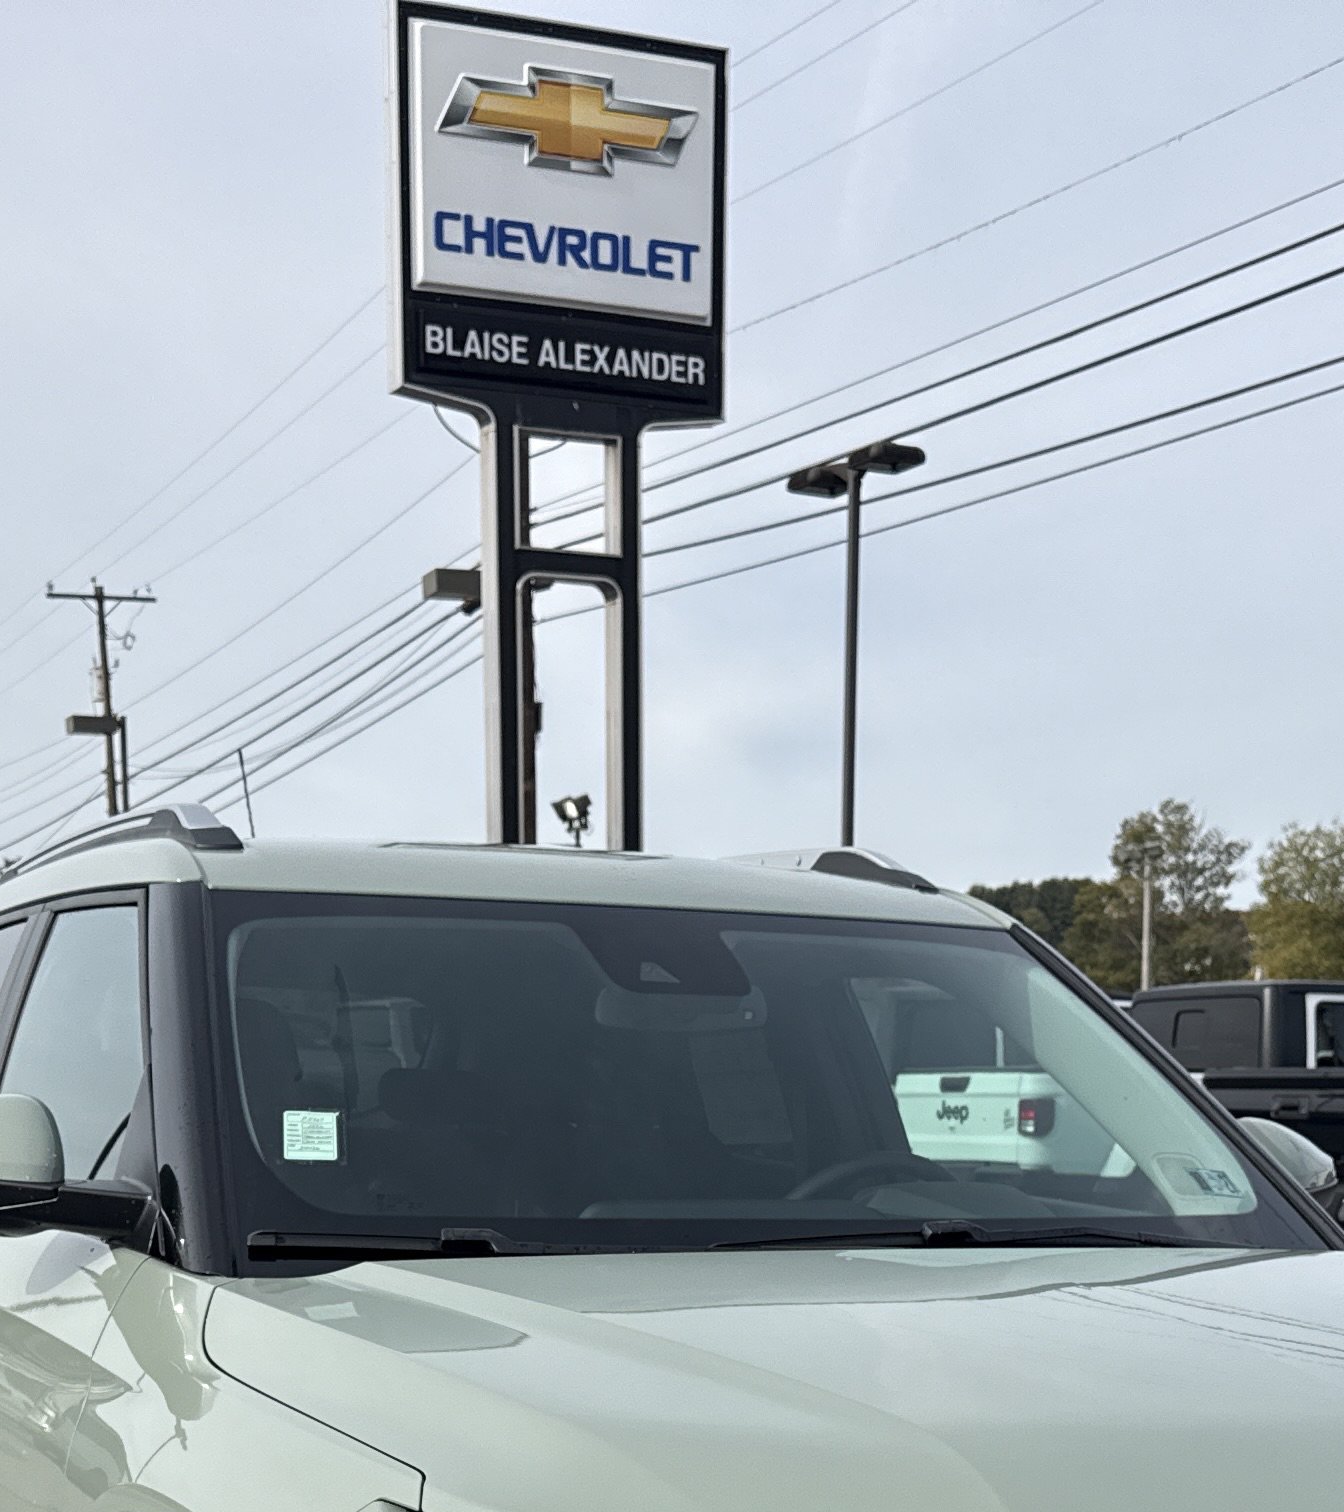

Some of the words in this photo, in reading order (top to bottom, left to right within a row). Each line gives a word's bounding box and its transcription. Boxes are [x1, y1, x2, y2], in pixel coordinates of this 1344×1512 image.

[434, 210, 699, 283] CHEVROLET
[424, 324, 529, 366] BLAISE
[537, 339, 706, 386] ALEXANDER
[936, 1100, 970, 1122] Jeep
